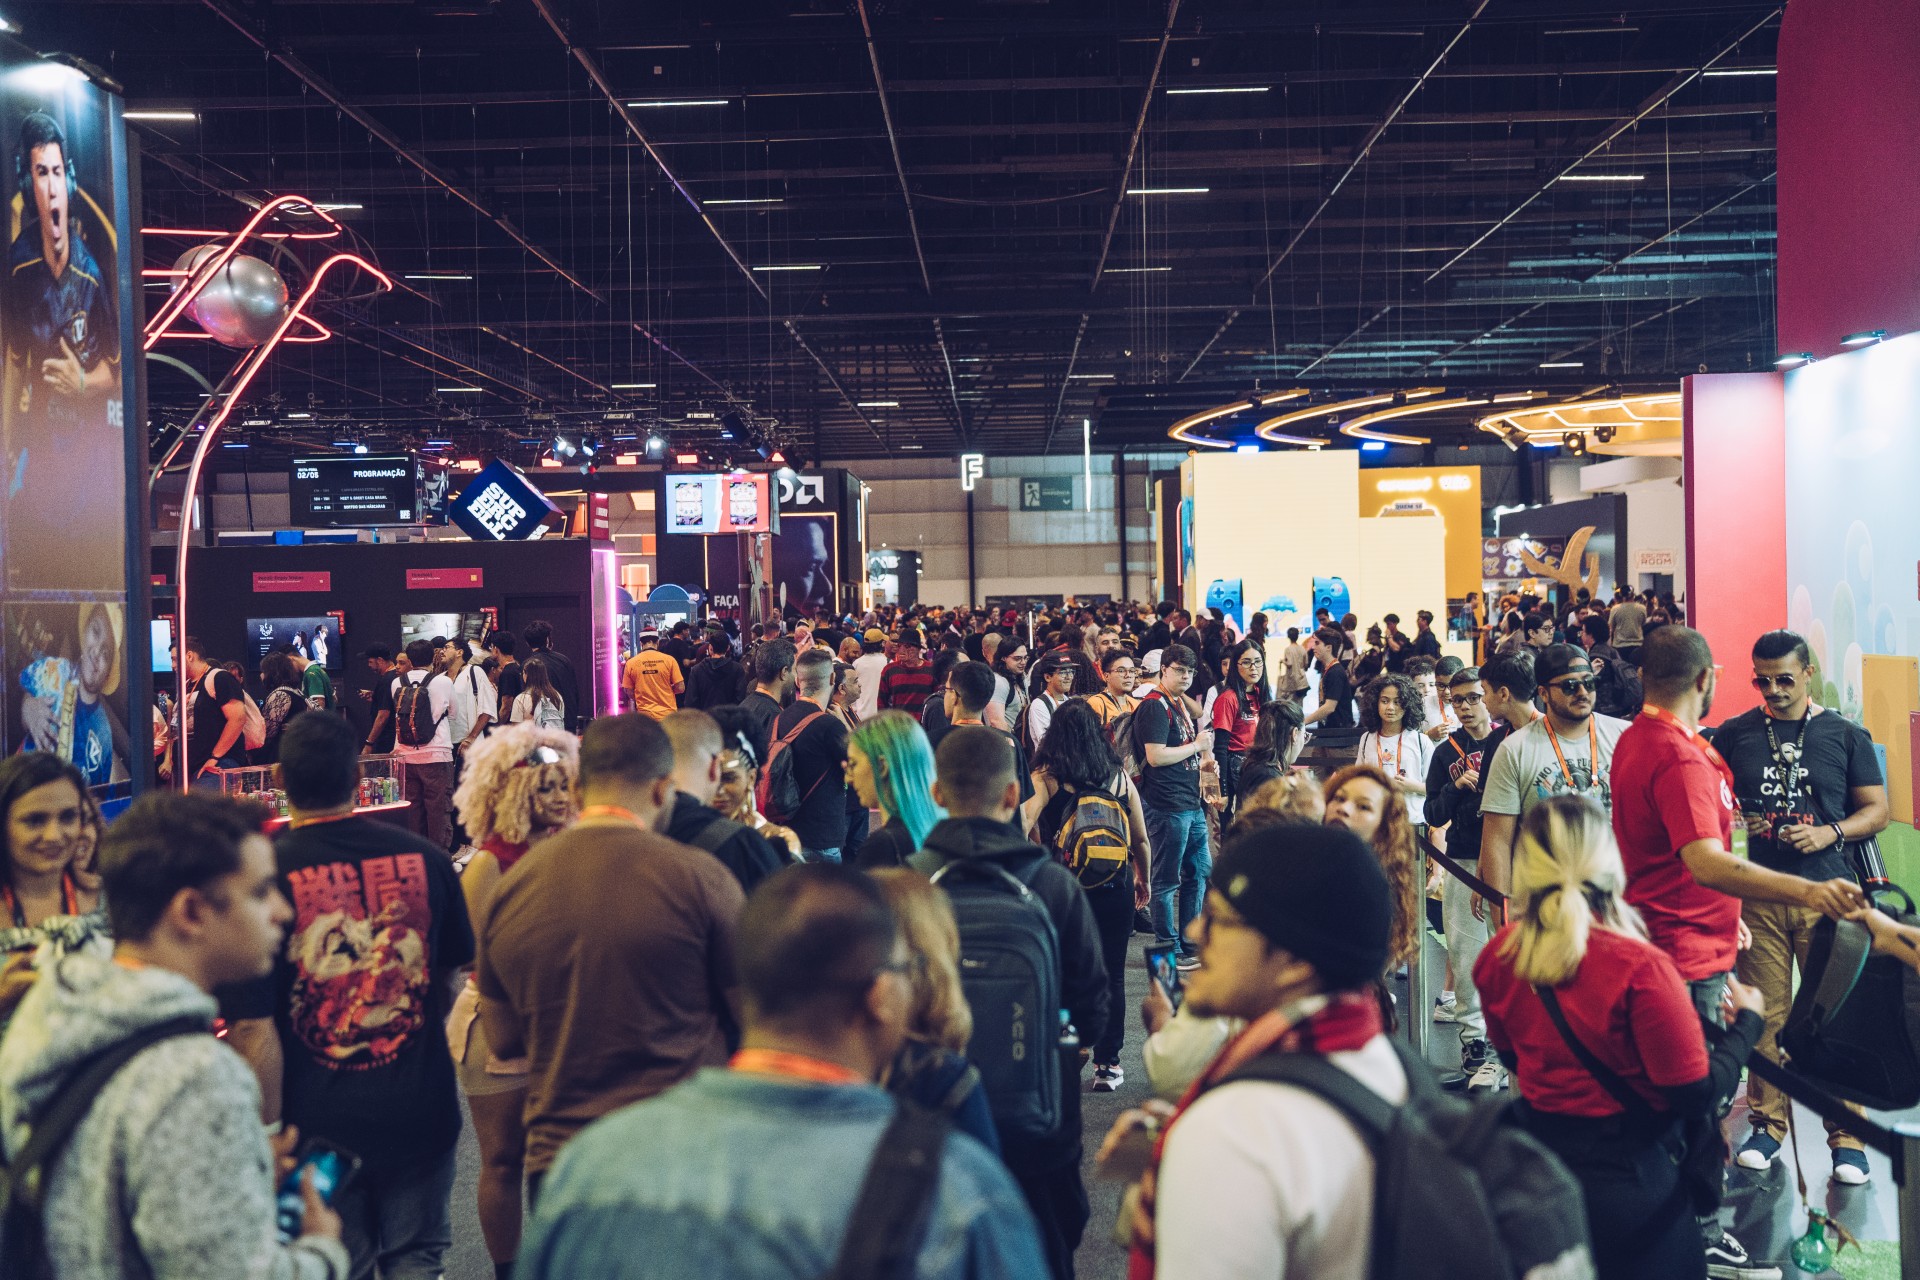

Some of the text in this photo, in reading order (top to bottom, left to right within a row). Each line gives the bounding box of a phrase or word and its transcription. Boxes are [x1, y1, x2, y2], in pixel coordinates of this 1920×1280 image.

[353, 468, 406, 478] PROGRAMAÇÃO
[961, 454, 983, 491] F
[476, 490, 519, 531] ERC
[485, 482, 527, 520] SUP
[467, 499, 506, 541] ELL
[714, 595, 739, 609] FAÇA
[1533, 766, 1552, 787] WHO
